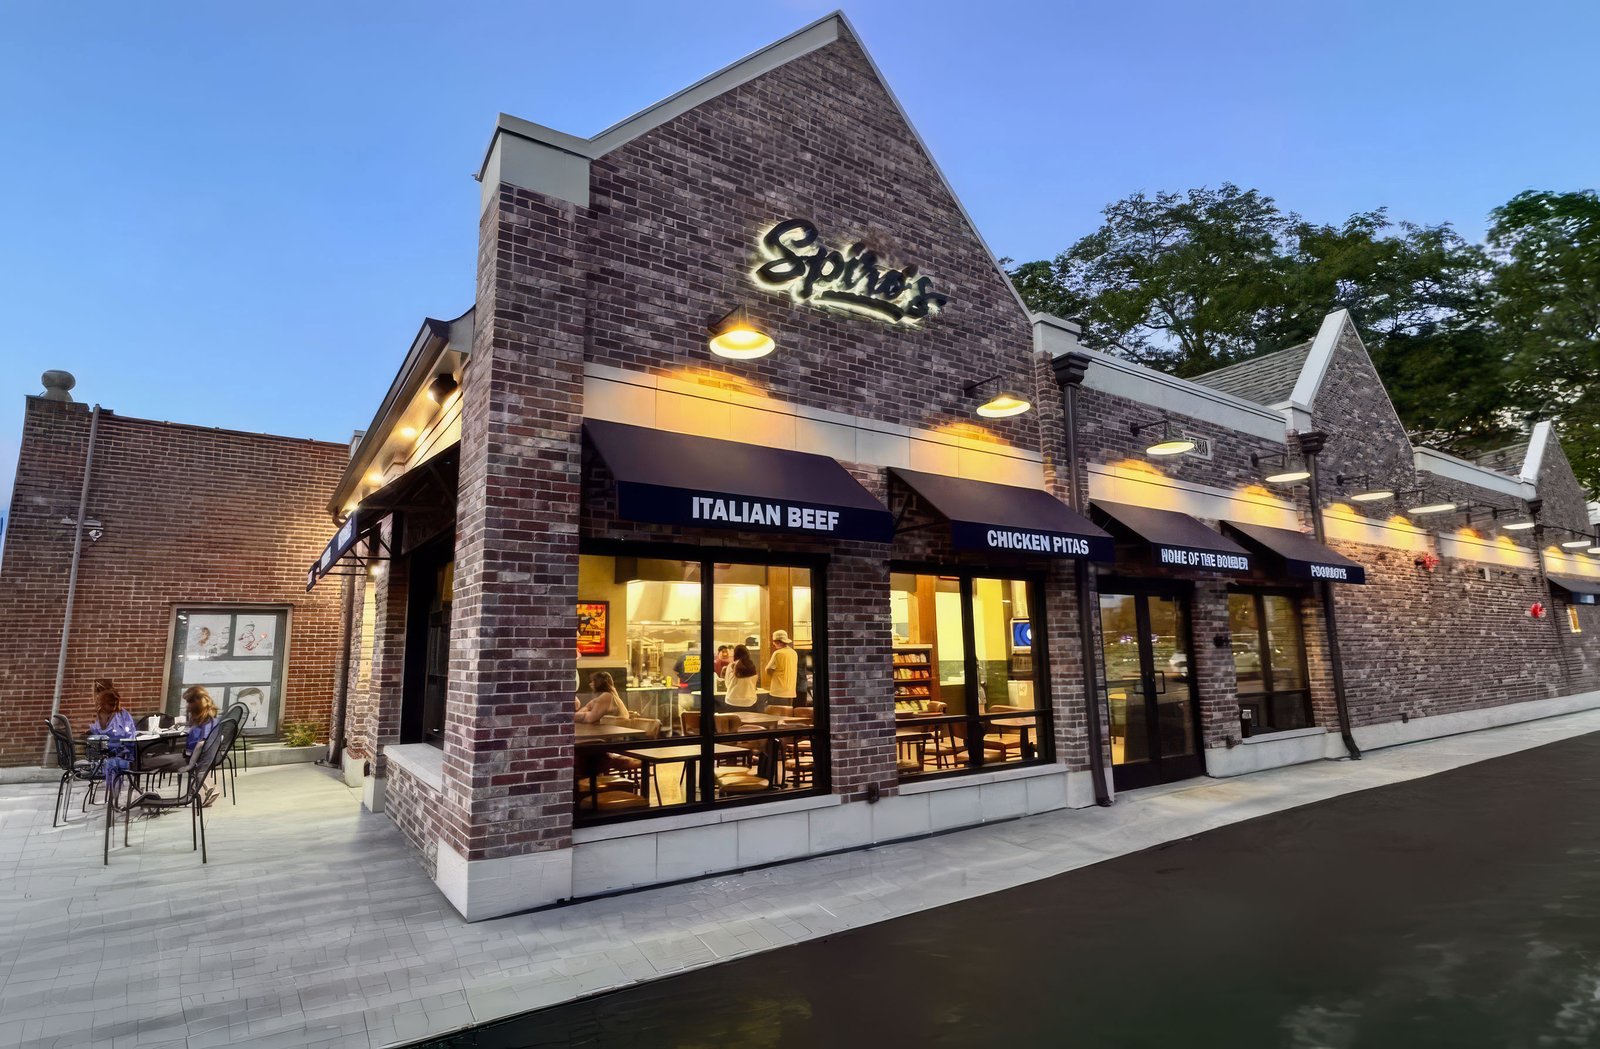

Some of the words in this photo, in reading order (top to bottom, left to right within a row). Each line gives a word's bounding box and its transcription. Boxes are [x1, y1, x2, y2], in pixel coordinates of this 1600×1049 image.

[692, 496, 781, 526] ITALIAN
[787, 506, 840, 531] BEEF
[987, 529, 1051, 552] CHICKEN
[1052, 536, 1090, 555] PITAS
[1161, 548, 1188, 565] HOME
[1188, 551, 1200, 566] OF
[1200, 553, 1216, 567] THE
